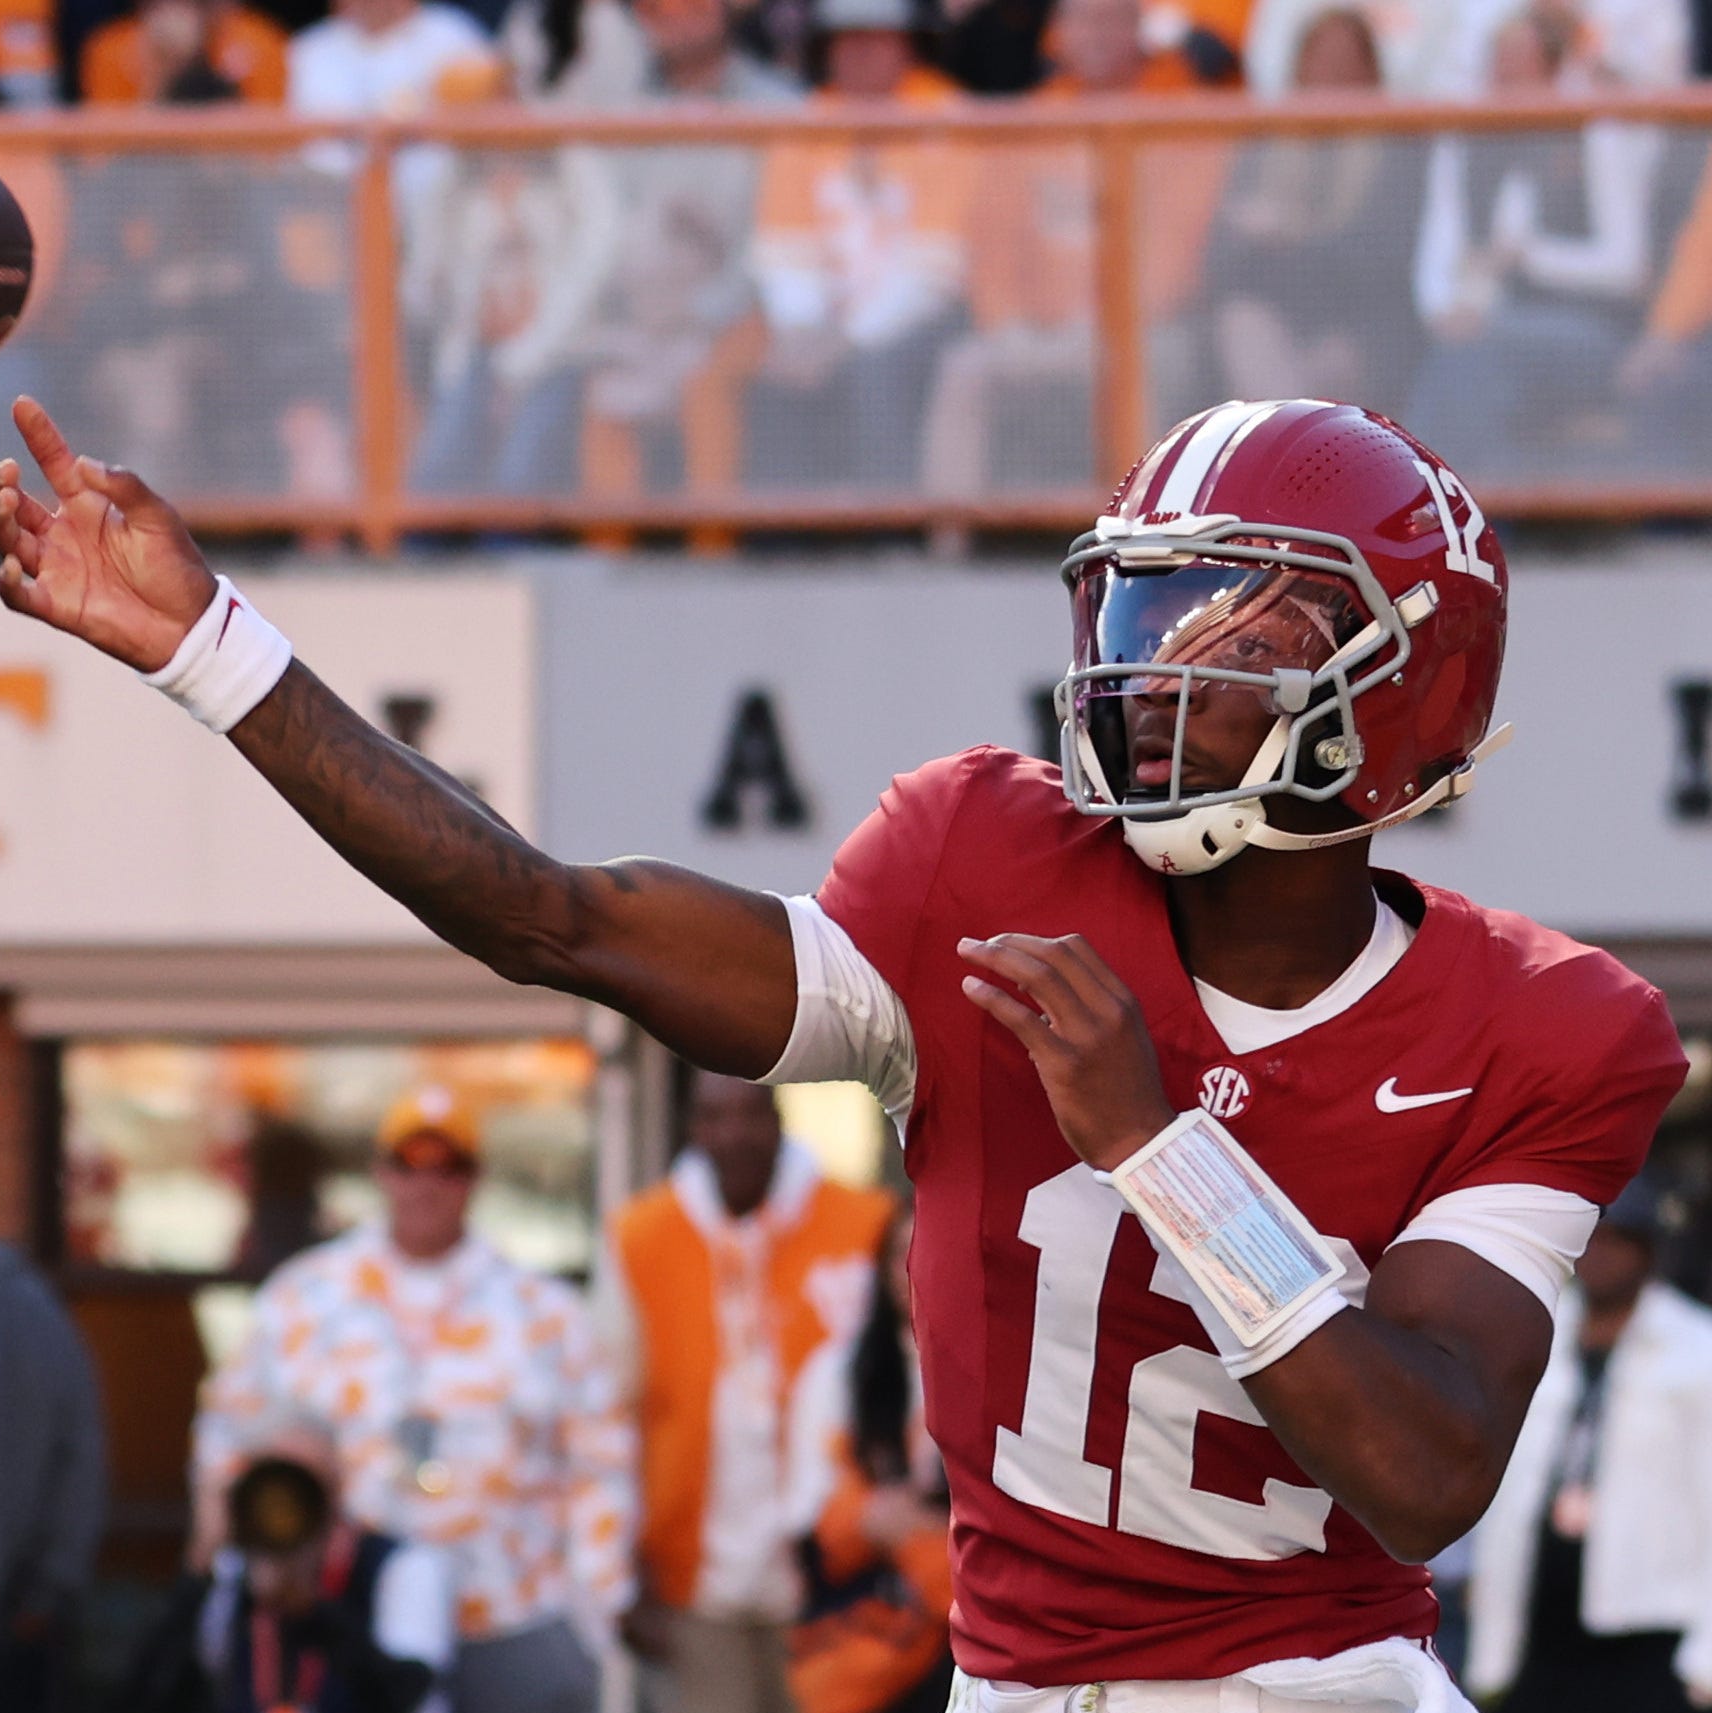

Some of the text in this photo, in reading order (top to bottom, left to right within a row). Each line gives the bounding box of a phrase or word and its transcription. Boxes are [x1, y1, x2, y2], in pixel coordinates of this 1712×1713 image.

[1412, 460, 1495, 585] 12
[1198, 1066, 1250, 1118] SEC
[992, 1160, 1371, 1562] 12
